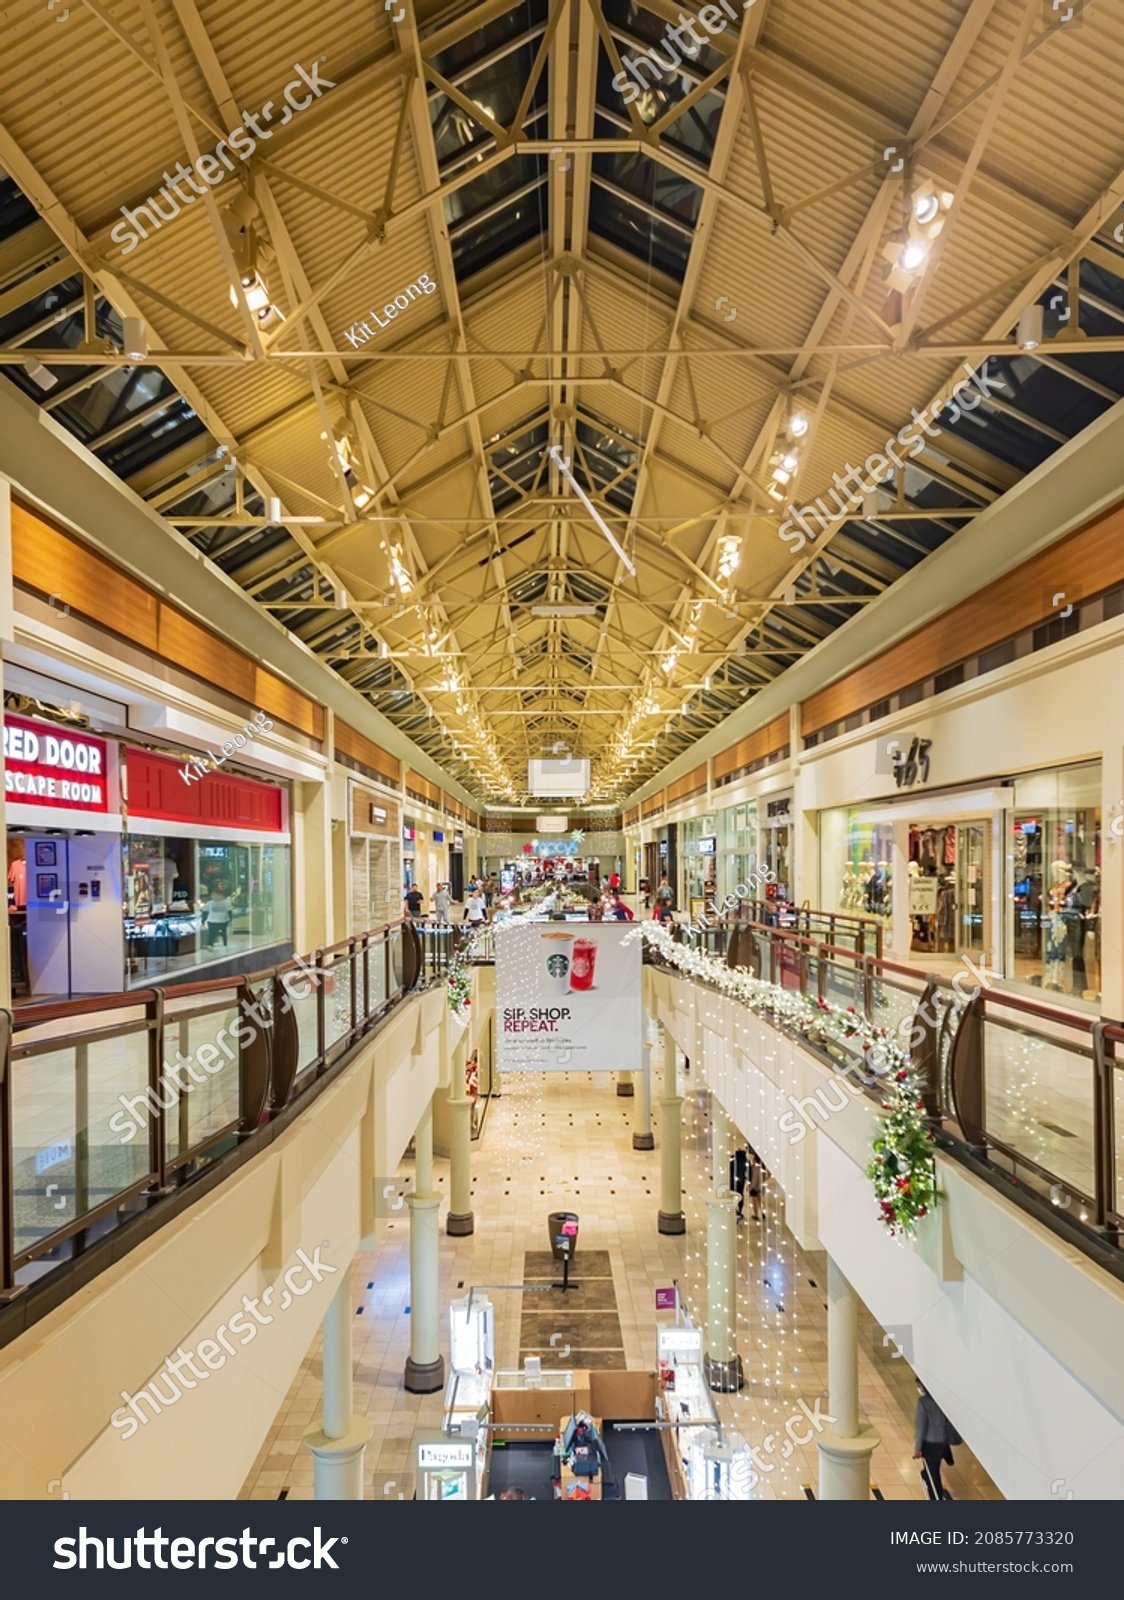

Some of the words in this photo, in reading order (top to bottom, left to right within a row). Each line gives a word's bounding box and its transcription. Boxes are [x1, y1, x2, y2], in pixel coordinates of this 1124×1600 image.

[45, 735, 101, 775] DOOR
[61, 779, 102, 804] ROOM
[503, 1007, 527, 1020] SIP.
[529, 1007, 572, 1020] SHOP.
[503, 1020, 558, 1033] REPEAT.
[421, 1448, 470, 1464] Pagoda
